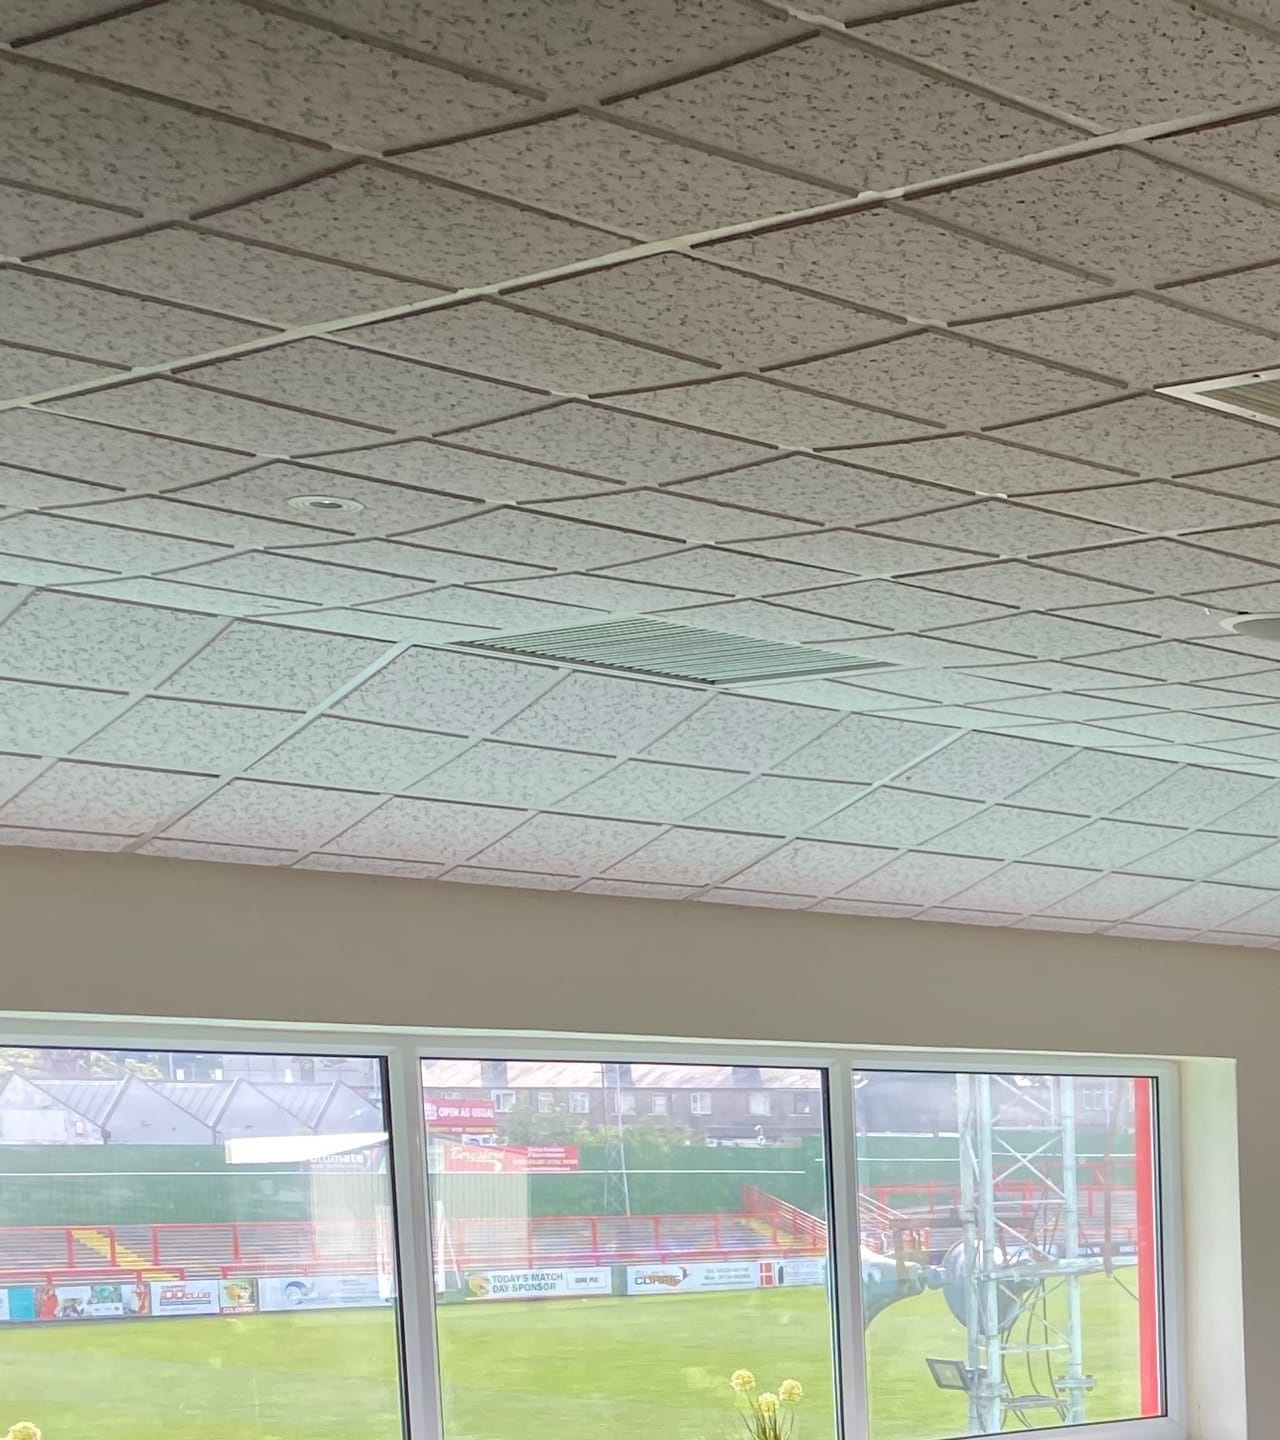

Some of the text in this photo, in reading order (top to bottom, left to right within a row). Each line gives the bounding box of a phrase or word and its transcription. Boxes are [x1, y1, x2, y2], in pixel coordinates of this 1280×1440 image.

[438, 1106, 459, 1118] OPEN
[460, 1107, 471, 1118] AS
[471, 1107, 495, 1119] USUAL
[492, 1272, 528, 1284] TODAY'S
[531, 1272, 563, 1283] MATCH
[492, 1282, 557, 1294] DAY SPONSOR
